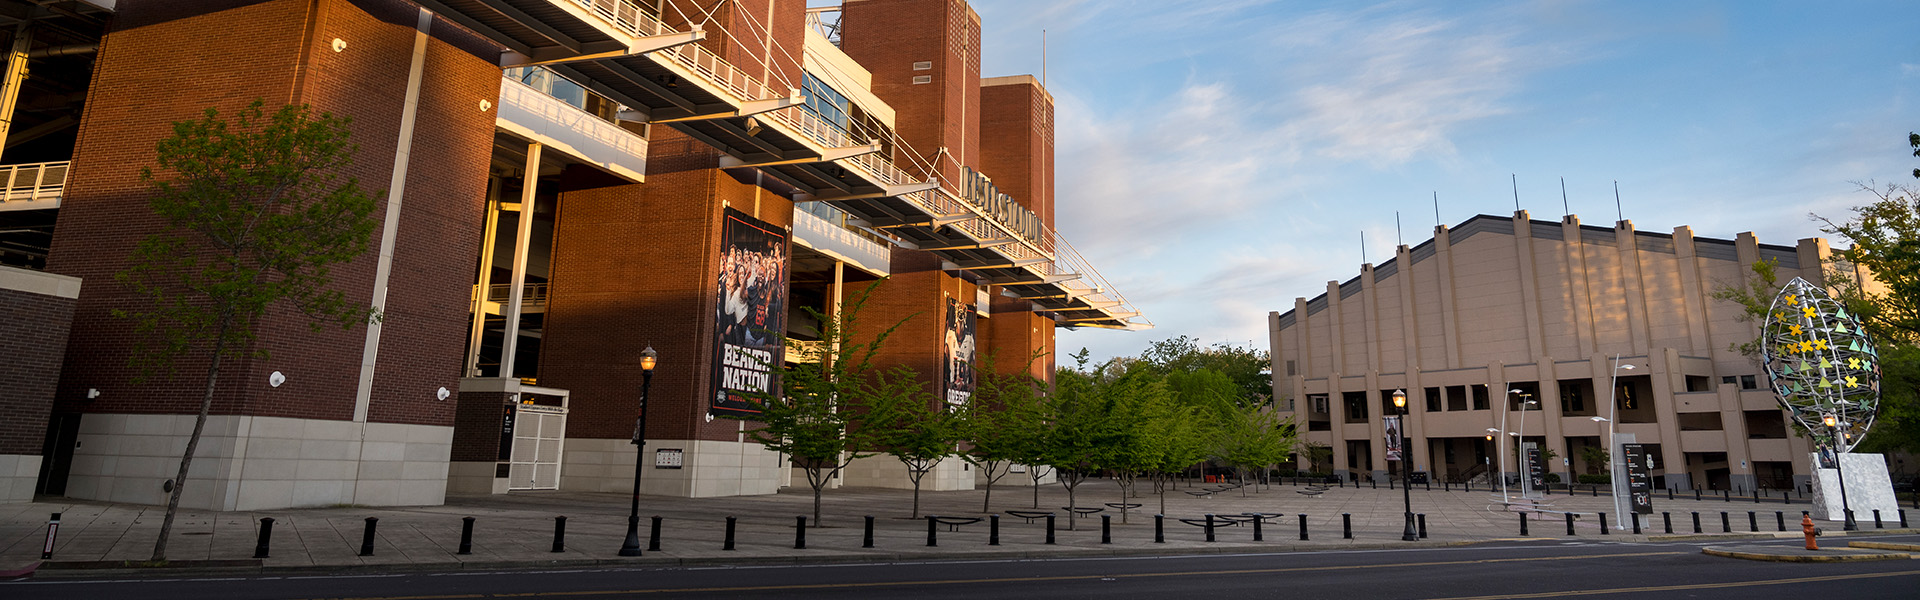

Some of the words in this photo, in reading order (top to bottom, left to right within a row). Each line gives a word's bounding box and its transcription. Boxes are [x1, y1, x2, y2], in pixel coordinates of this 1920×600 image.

[962, 166, 999, 218] RESER
[1000, 194, 1042, 246] STADIUM
[723, 343, 771, 372] BEAVER
[722, 366, 769, 393] NATION
[728, 395, 747, 403] WELCO
